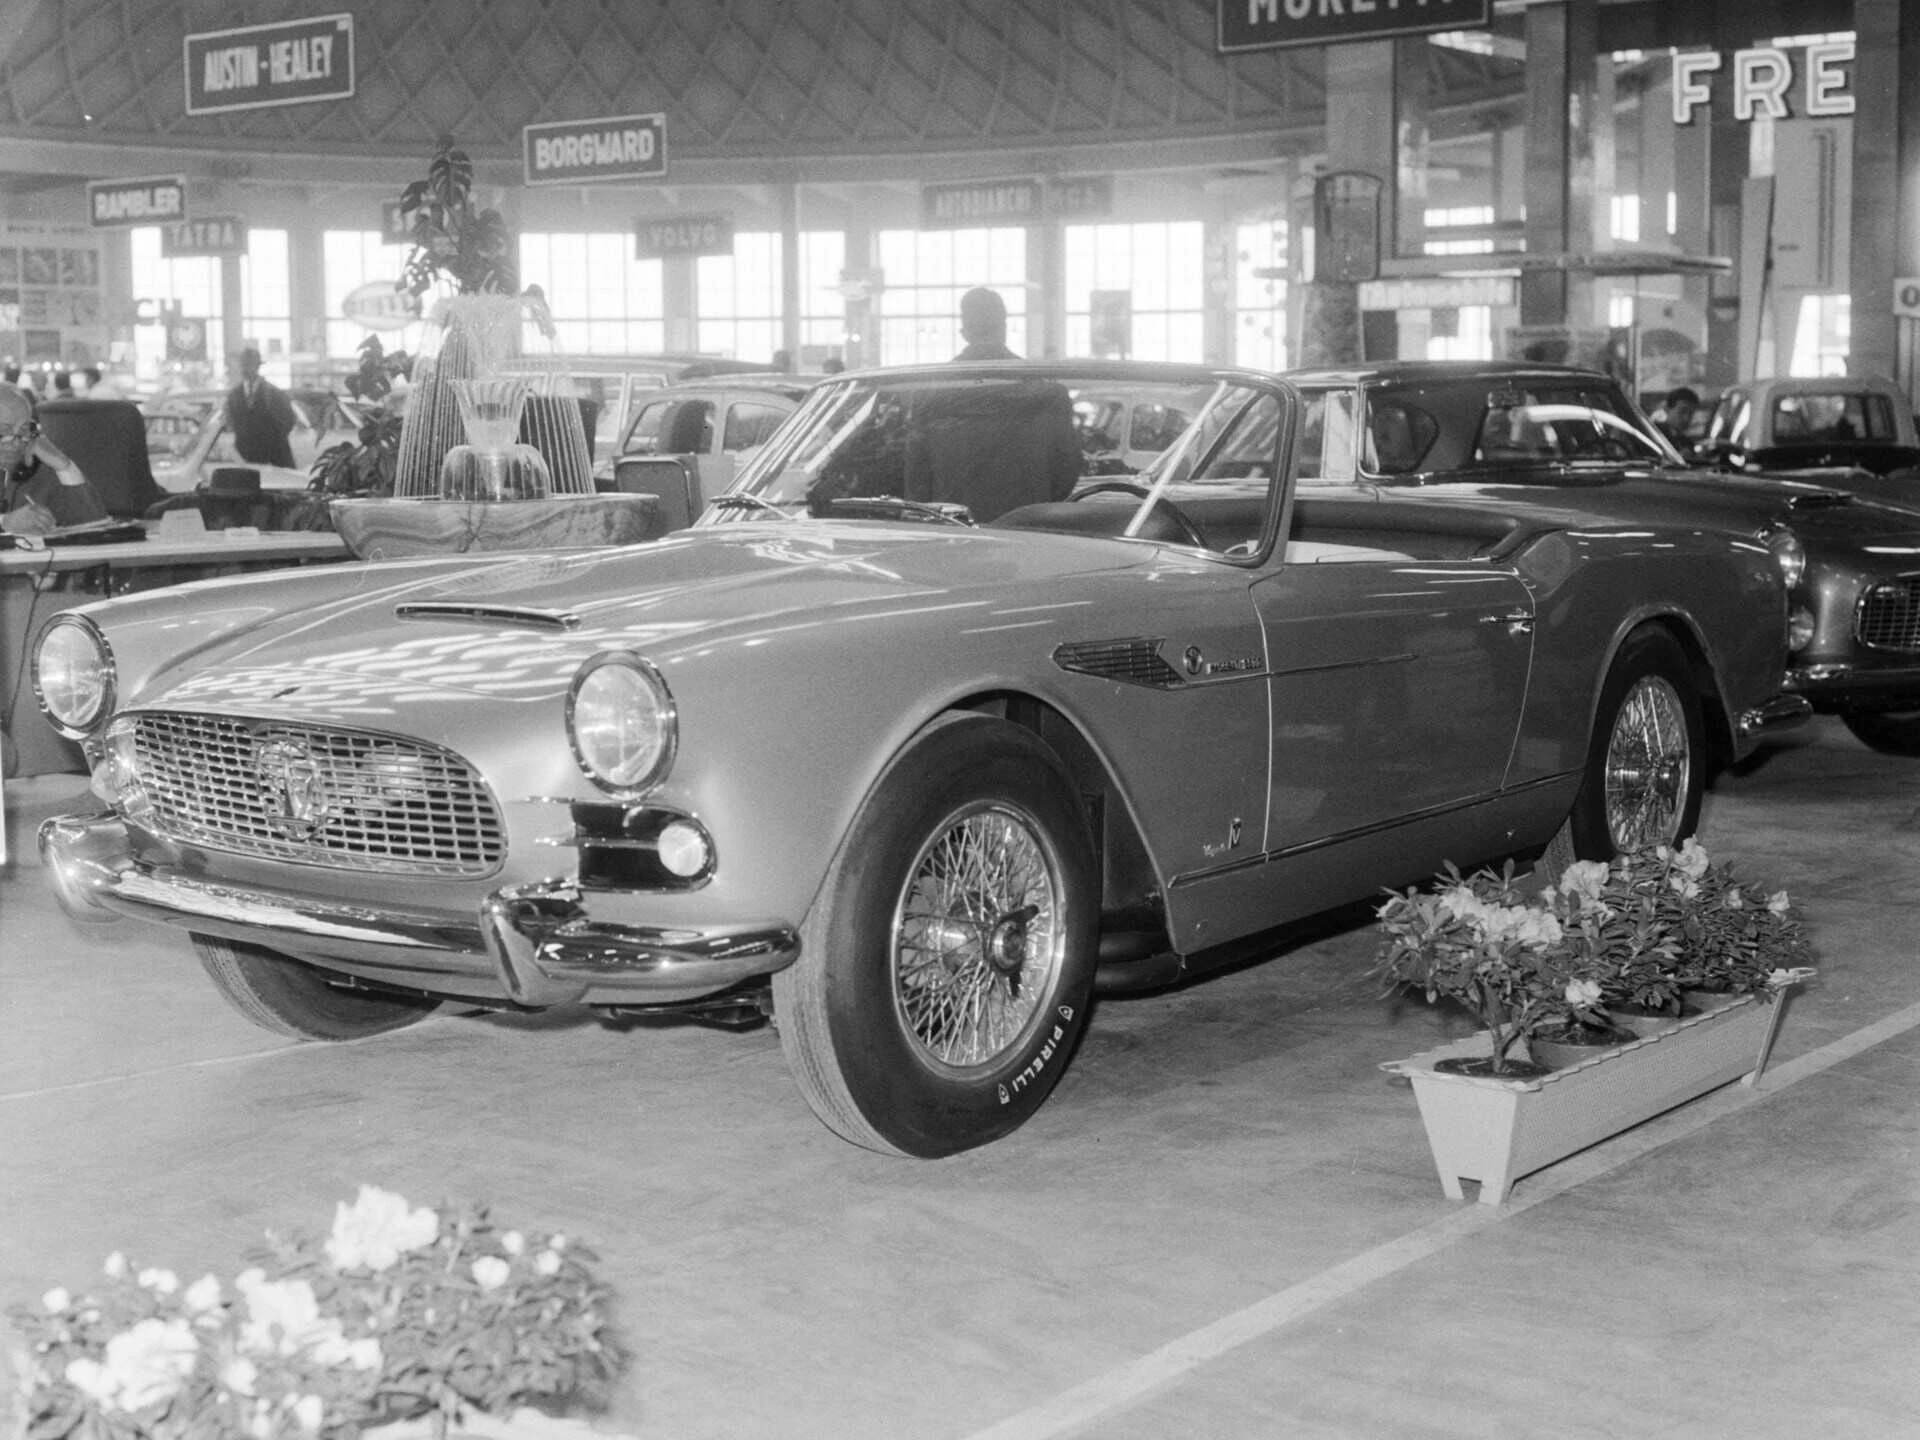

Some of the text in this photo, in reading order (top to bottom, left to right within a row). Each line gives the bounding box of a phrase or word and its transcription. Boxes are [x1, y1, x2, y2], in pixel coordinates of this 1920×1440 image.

[1673, 43, 1856, 124] FRE
[535, 128, 655, 170] BORGWARD
[95, 187, 181, 220] RAMBLER
[650, 222, 716, 247] VOLVO
[1011, 1025, 1064, 1093] PIRELLI
